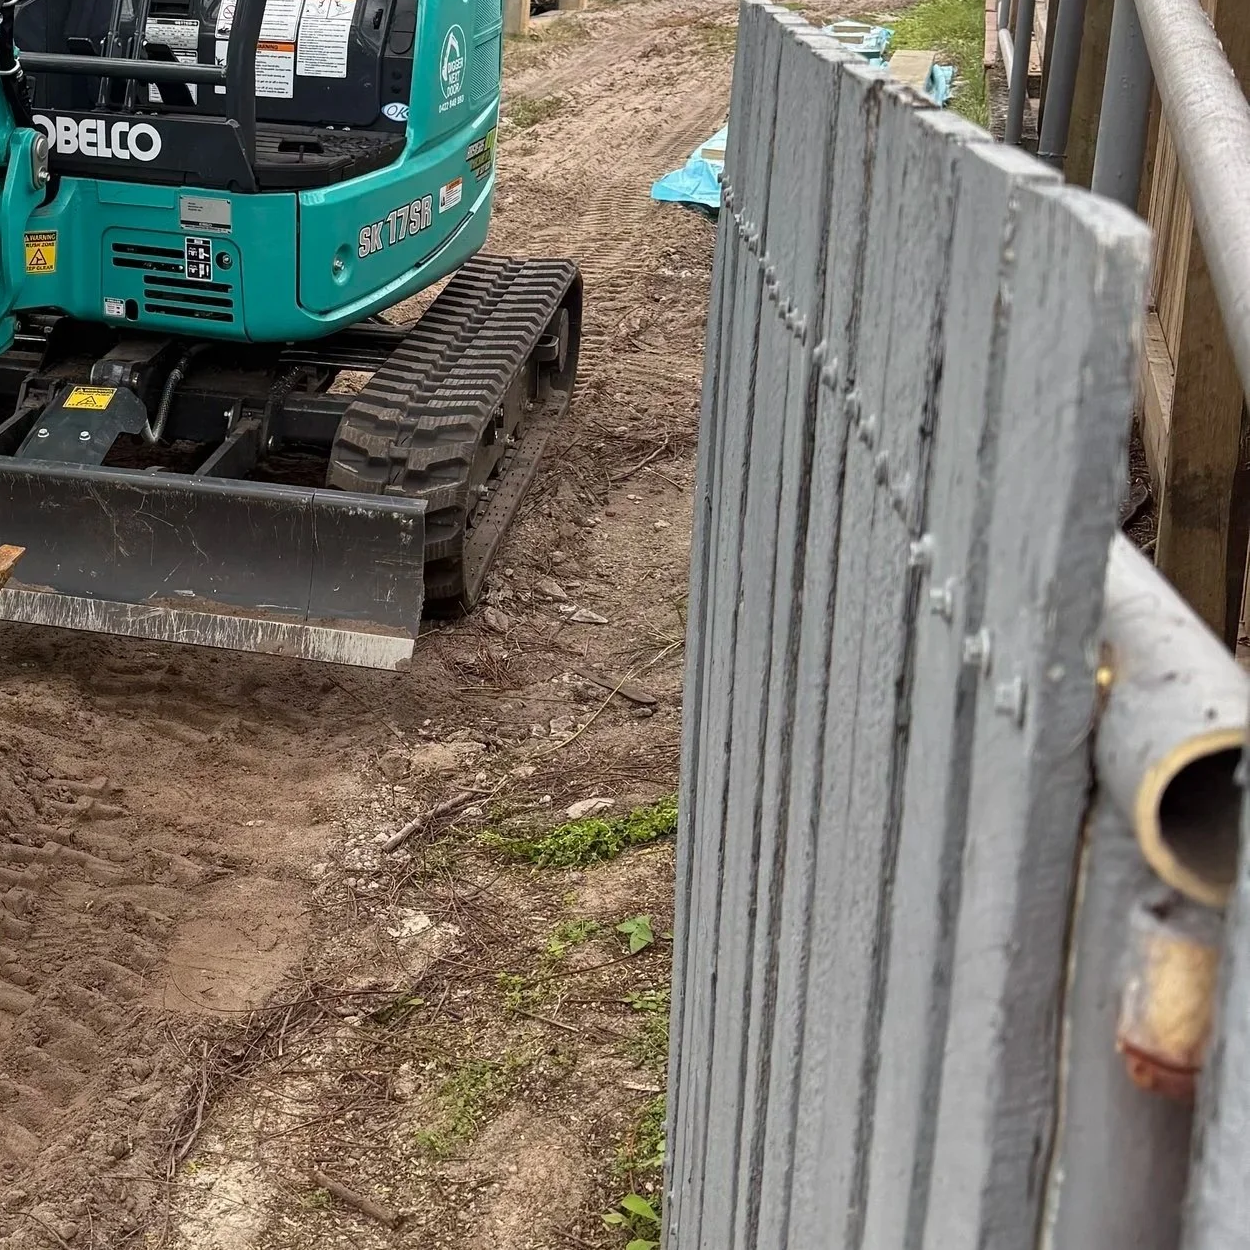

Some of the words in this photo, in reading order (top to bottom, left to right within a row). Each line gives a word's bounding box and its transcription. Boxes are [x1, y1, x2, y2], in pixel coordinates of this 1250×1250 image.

[448, 57, 463, 74] DIGGER
[448, 70, 460, 85] NEXT
[447, 83, 460, 97] DOOR
[32, 114, 162, 162] OBELCO
